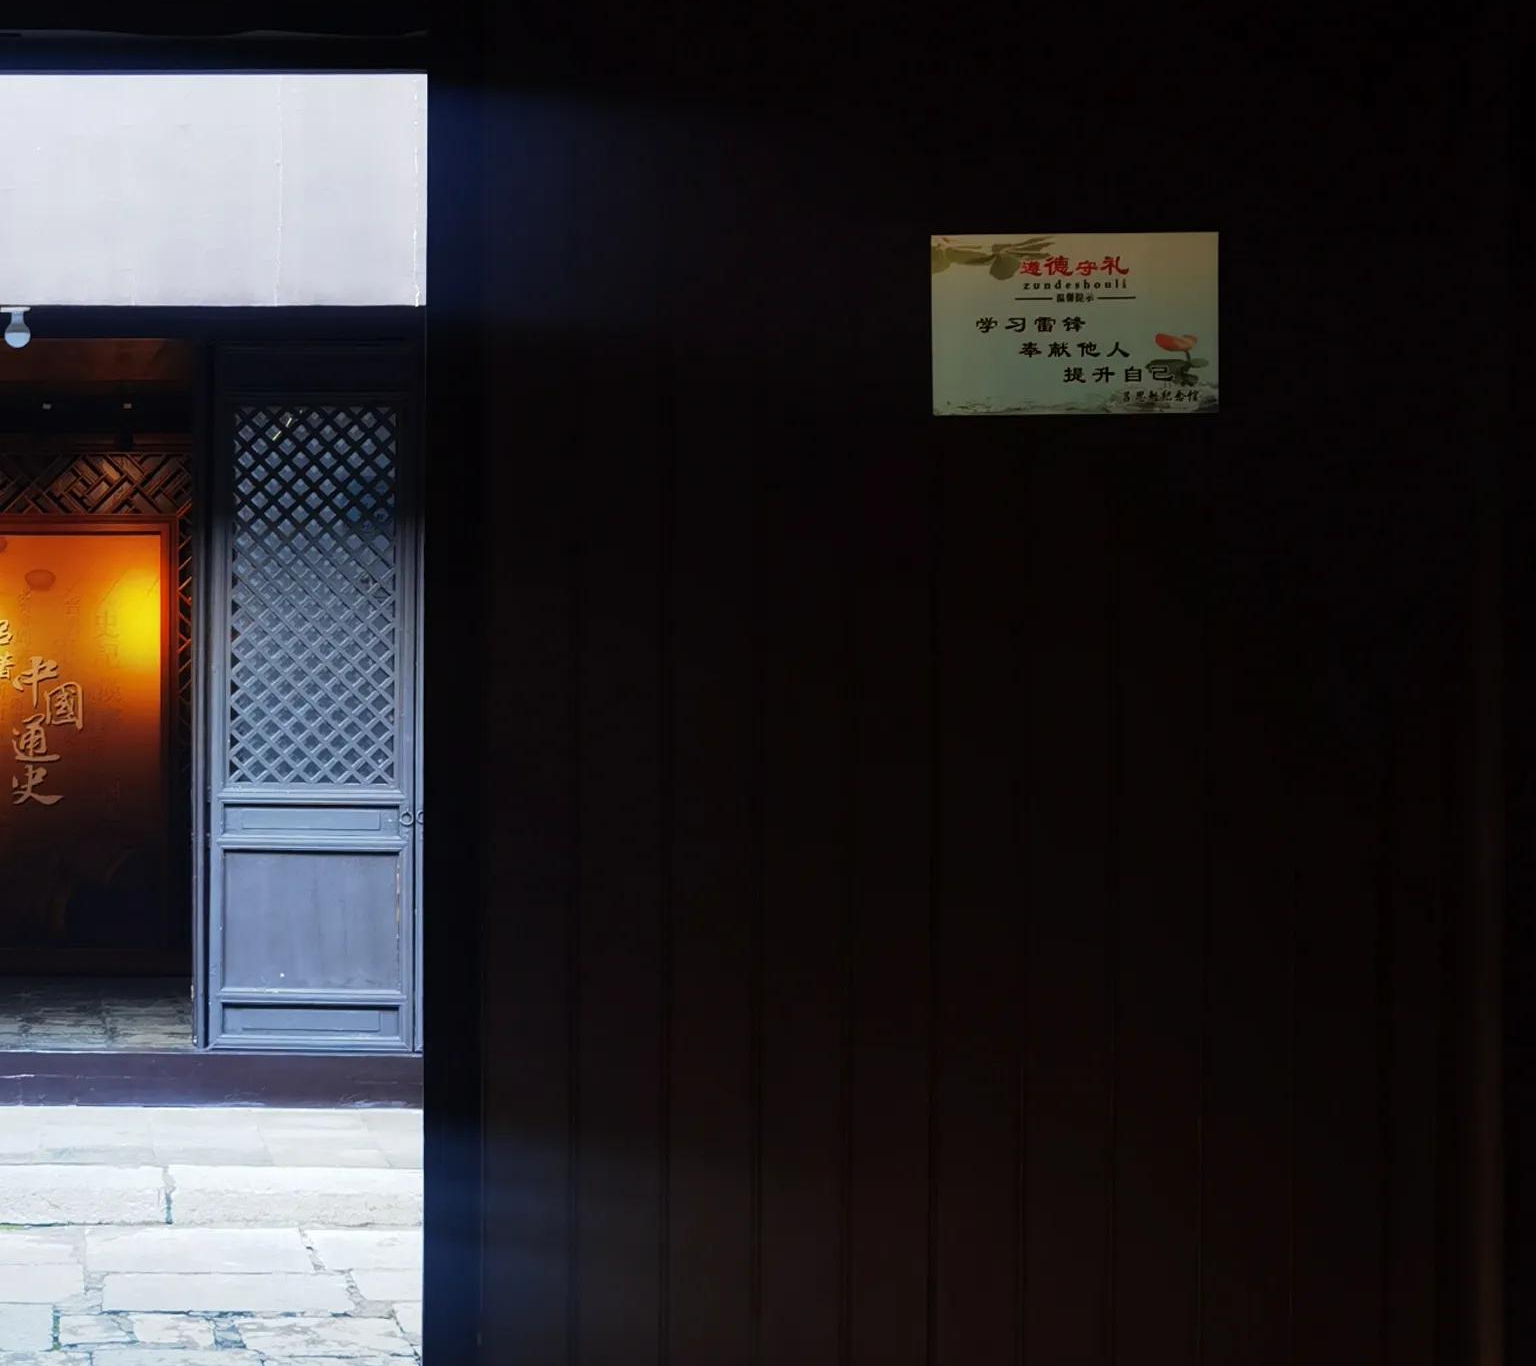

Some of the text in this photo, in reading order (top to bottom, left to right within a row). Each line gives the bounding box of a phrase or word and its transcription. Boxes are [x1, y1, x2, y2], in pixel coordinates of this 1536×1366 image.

[1019, 255, 1129, 277] 遵德守礼
[975, 316, 1086, 333] 学习雷锋
[1018, 341, 1131, 358] 奉献他人
[1063, 366, 1173, 384] 提升自己
